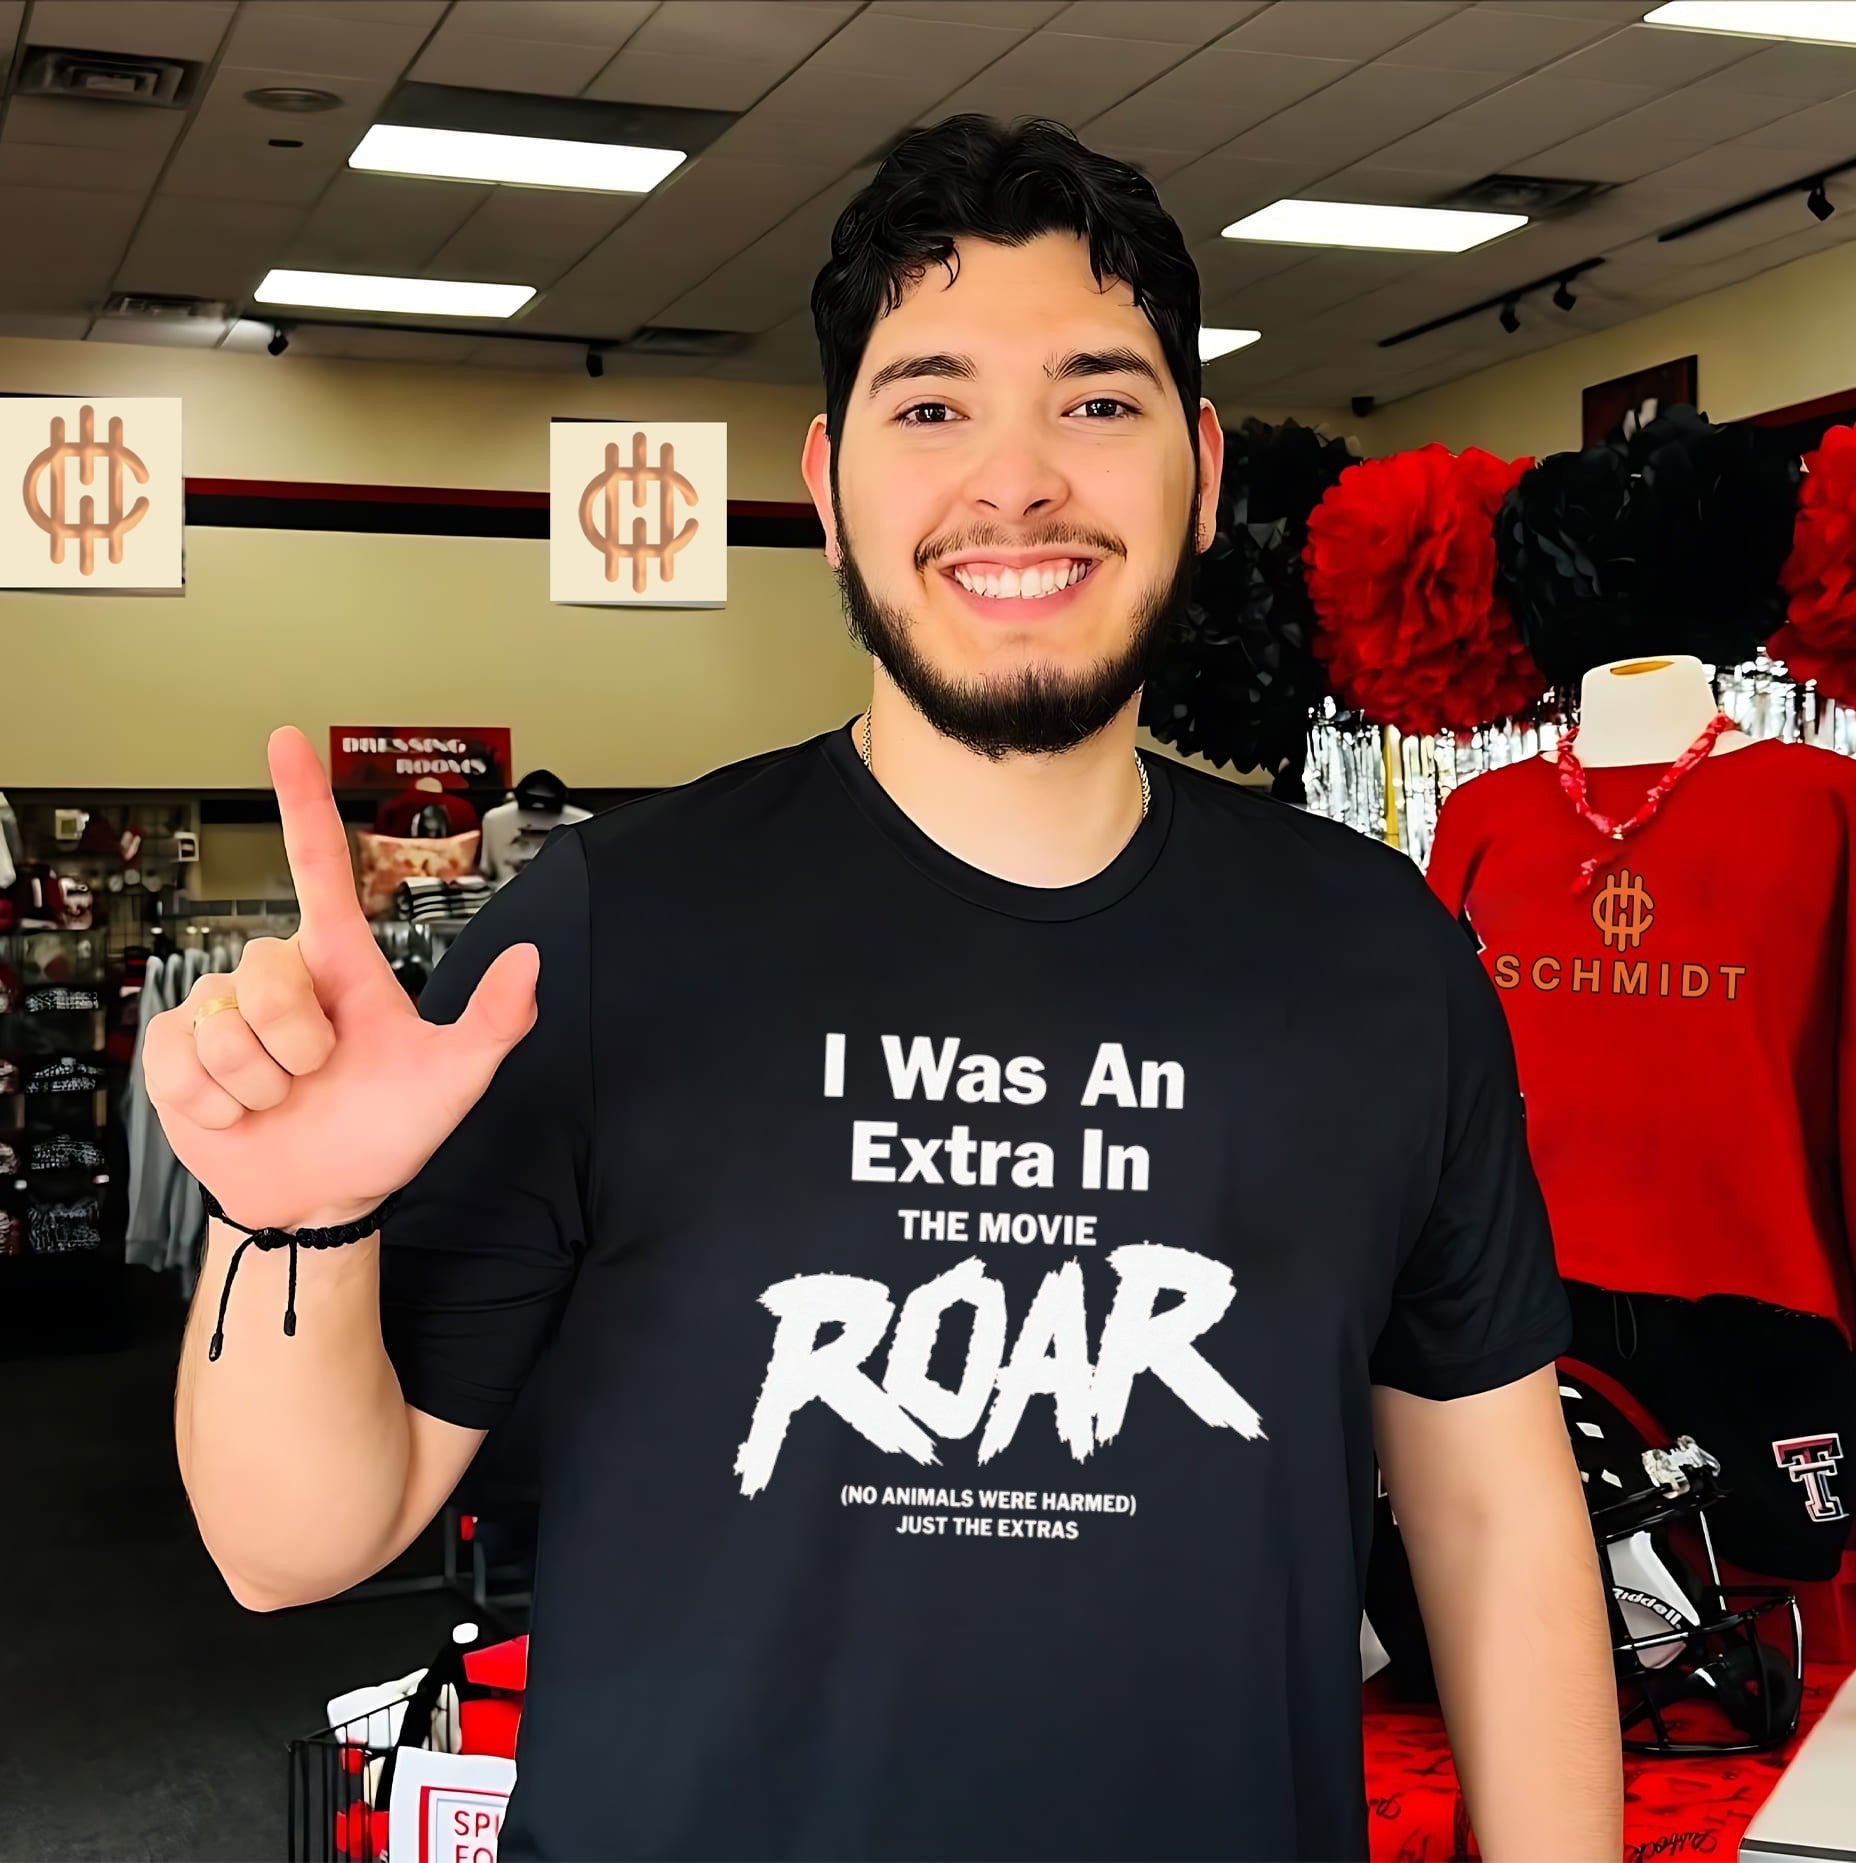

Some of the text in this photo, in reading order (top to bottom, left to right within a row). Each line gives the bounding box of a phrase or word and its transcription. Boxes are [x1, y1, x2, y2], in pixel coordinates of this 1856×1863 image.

[396, 758, 487, 774] ROOMS
[1494, 954, 1747, 1001] SCHMIDT
[824, 1033, 1184, 1109] I Was An
[852, 1121, 1149, 1191] Extra In
[898, 1210, 1097, 1246] THE MOVIE
[733, 1240, 1268, 1500] ROAR
[841, 1485, 1136, 1516] (NO ANIMALS WERE HARMED)
[896, 1516, 1079, 1539] JUST THE EXTRAS
